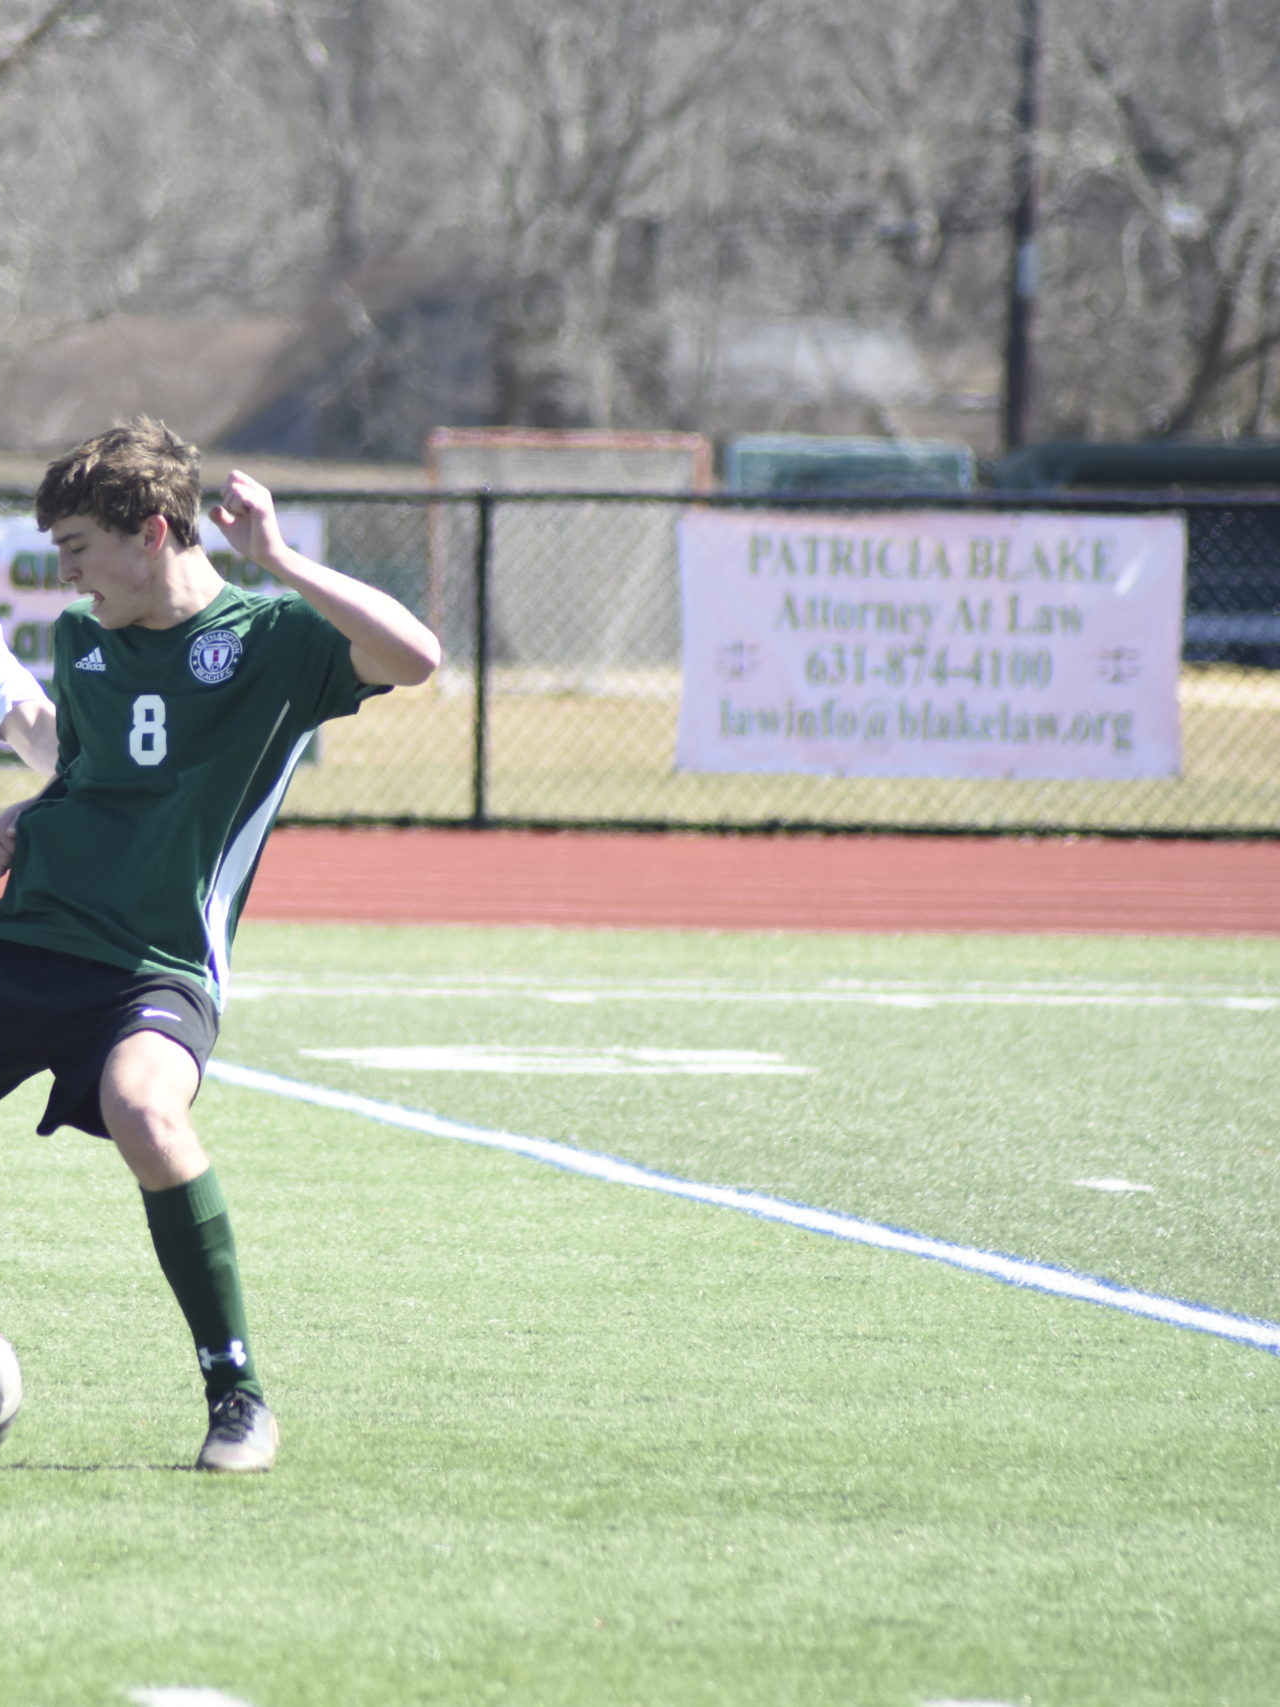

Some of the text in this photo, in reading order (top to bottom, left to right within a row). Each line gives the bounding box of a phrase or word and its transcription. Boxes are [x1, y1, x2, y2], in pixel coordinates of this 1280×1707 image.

[747, 534, 1117, 583] PATRICIA BLAKE
[774, 593, 1085, 637] Attorney At Law
[75, 660, 106, 672] adidas
[804, 645, 1054, 689] 631-874-4100
[130, 694, 167, 766] 8
